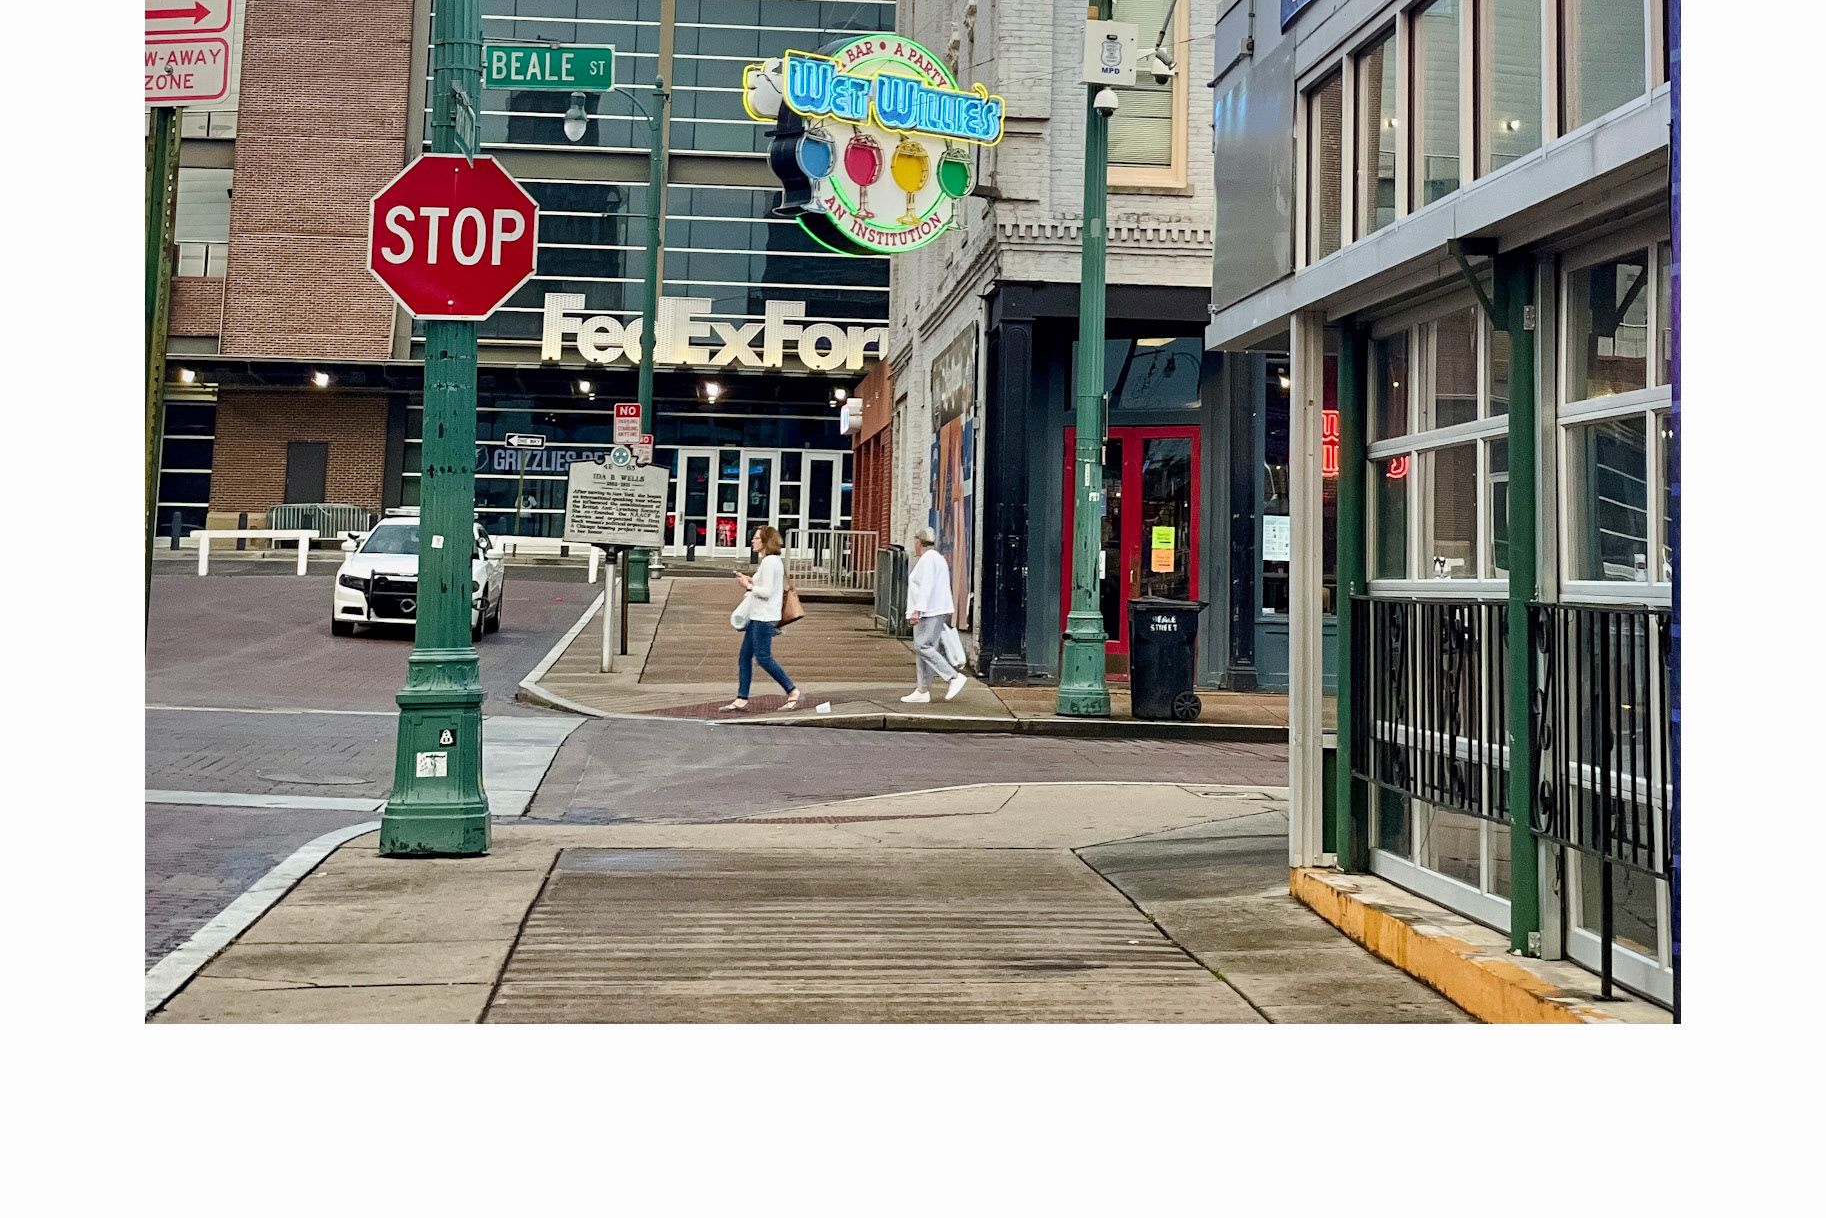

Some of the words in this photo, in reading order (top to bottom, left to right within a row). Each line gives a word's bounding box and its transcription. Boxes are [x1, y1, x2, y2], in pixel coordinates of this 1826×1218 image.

[492, 51, 575, 81] BEALE
[589, 60, 606, 76] ST
[846, 40, 874, 63] BAR
[893, 42, 904, 56] A
[907, 50, 949, 88] PARTY
[1101, 66, 1121, 75] MPD
[145, 74, 194, 91] ZONE
[788, 57, 871, 119] WET
[824, 195, 847, 221] AN
[381, 205, 526, 266] STOP
[850, 213, 942, 247] INSTITUTION
[541, 293, 889, 370] FedExFor
[620, 406, 636, 416] NO
[620, 474, 645, 482] WELLS
